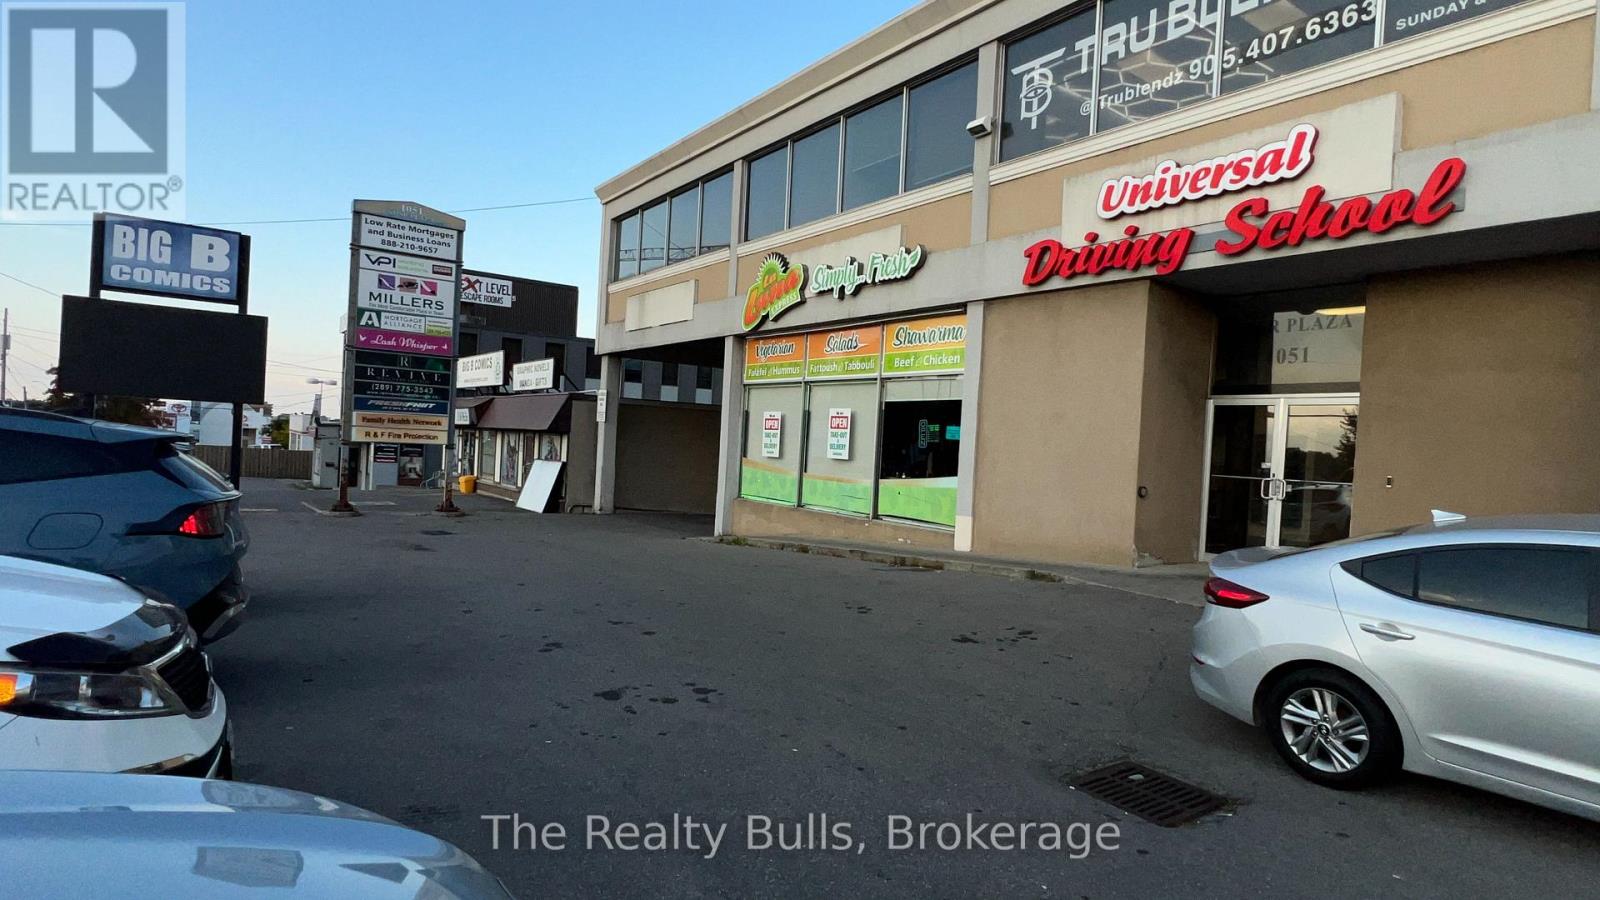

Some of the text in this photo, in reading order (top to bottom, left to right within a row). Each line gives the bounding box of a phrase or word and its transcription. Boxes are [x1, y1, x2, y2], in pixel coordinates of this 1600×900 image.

[1395, 0, 1467, 30] SUNDAY
[1099, 127, 1314, 217] Universal
[365, 217, 455, 240] Low Rate Mortgages
[1022, 158, 1467, 286] Driving School
[368, 228, 451, 248] and Business Loans
[381, 239, 438, 254] 888-210-9657
[112, 224, 231, 272] BIG B
[365, 253, 396, 268] VPI
[866, 247, 910, 283] Fresh
[110, 264, 231, 294] COMICS
[486, 281, 511, 296] LEVEL
[369, 291, 444, 311] MILLERS
[484, 294, 504, 304] ROOMS
[384, 315, 422, 324] MORTGAGE
[384, 321, 422, 330] ALLIANCE
[1287, 314, 1353, 333] PLAZA
[370, 334, 438, 351] Lash Whisper
[824, 333, 862, 354] Salads
[892, 325, 965, 348] Shawarma
[755, 340, 795, 362] Vegetarian
[894, 353, 960, 368] Beef Chicken
[773, 365, 800, 375] Hummus
[371, 383, 393, 391] (289)
[361, 416, 386, 425] Family
[387, 417, 411, 425] Health
[765, 419, 779, 429] OPEN
[831, 418, 848, 429] OPEN
